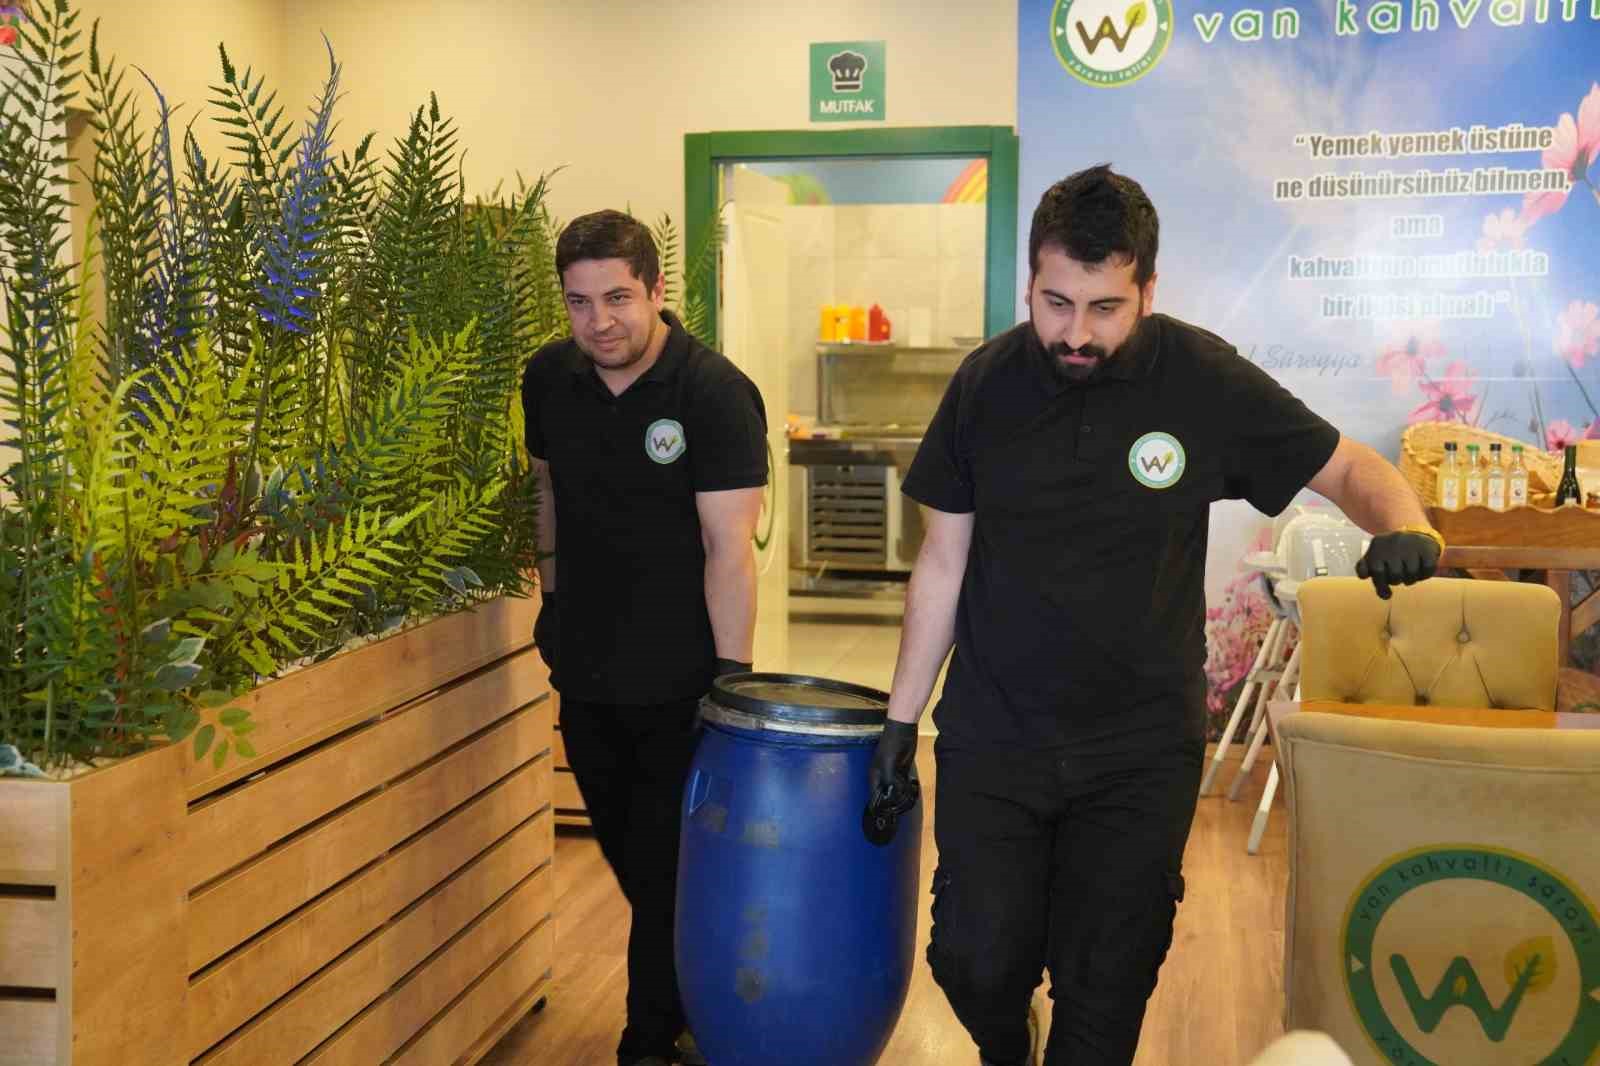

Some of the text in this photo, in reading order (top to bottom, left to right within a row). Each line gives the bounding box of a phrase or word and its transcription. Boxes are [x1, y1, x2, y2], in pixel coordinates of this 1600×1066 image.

[1194, 8, 1299, 42] van
[819, 99, 875, 113] MUTFAK
[1388, 129, 1465, 156] yemek
[1470, 126, 1553, 151] üstüne
[1275, 179, 1303, 199] ne
[1392, 216, 1442, 236] ama
